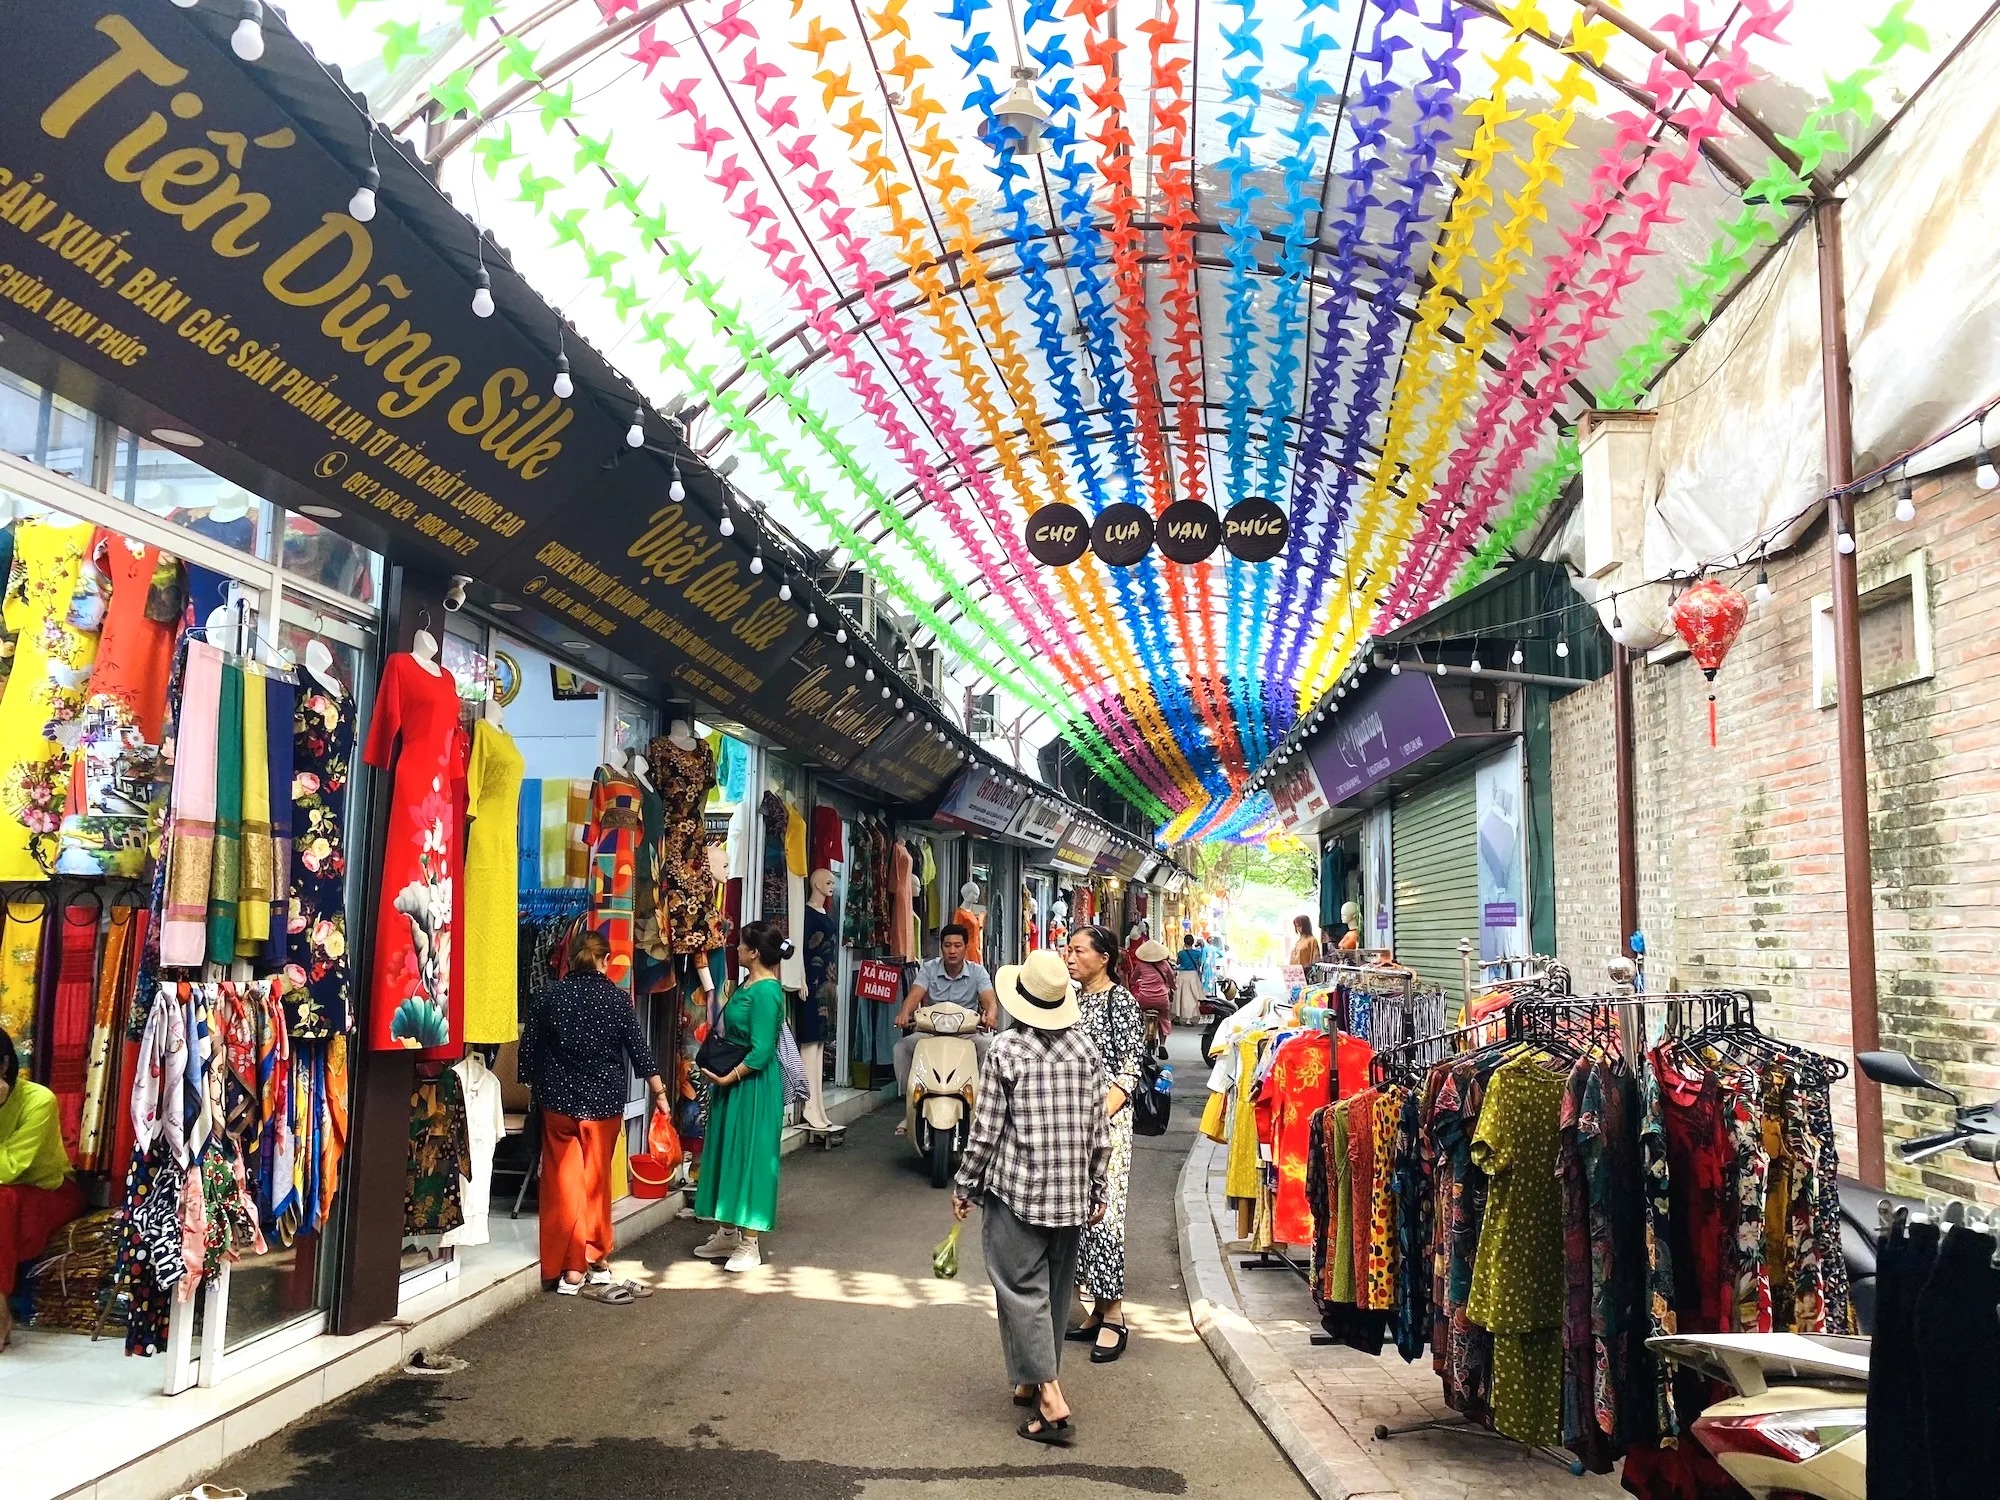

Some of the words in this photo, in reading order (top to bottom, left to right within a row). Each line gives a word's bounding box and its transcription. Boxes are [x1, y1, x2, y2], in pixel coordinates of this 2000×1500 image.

[40, 13, 296, 257] Tiến
[263, 212, 461, 418] Dũng
[448, 367, 574, 481] Silk
[44, 297, 99, 338] VẠN
[85, 322, 148, 366] PHÚC
[36, 211, 134, 288] XUẤT,
[117, 267, 192, 324] BÁN
[178, 310, 240, 356] CÁC
[227, 342, 287, 386] SẢN
[270, 374, 342, 422] PHẨM
[326, 405, 374, 450] LỤA
[360, 427, 399, 457] TƠ
[383, 440, 430, 480] TẰM
[415, 469, 467, 501] CHẤT
[450, 486, 506, 520] LƯỢNG
[491, 504, 526, 539] CAO
[341, 471, 382, 500] 0912
[367, 488, 397, 510] 168
[390, 502, 416, 523] 424
[413, 512, 446, 537] 0988
[452, 539, 480, 557] 472
[1035, 525, 1078, 547] CHỢ
[1104, 520, 1140, 545] LỤA
[1167, 520, 1207, 543] VẠN
[1225, 513, 1282, 538] PHÚC
[535, 540, 584, 577] CHUYÊN
[568, 560, 600, 586] SẢN
[626, 503, 724, 586] Việt
[682, 561, 764, 622] Anh
[731, 597, 799, 652] Silk
[603, 585, 634, 608] BÁN
[618, 594, 651, 619] BUÔN
[862, 963, 876, 979] XẢ
[878, 969, 898, 983] KHO
[864, 981, 891, 998] HÀNG
